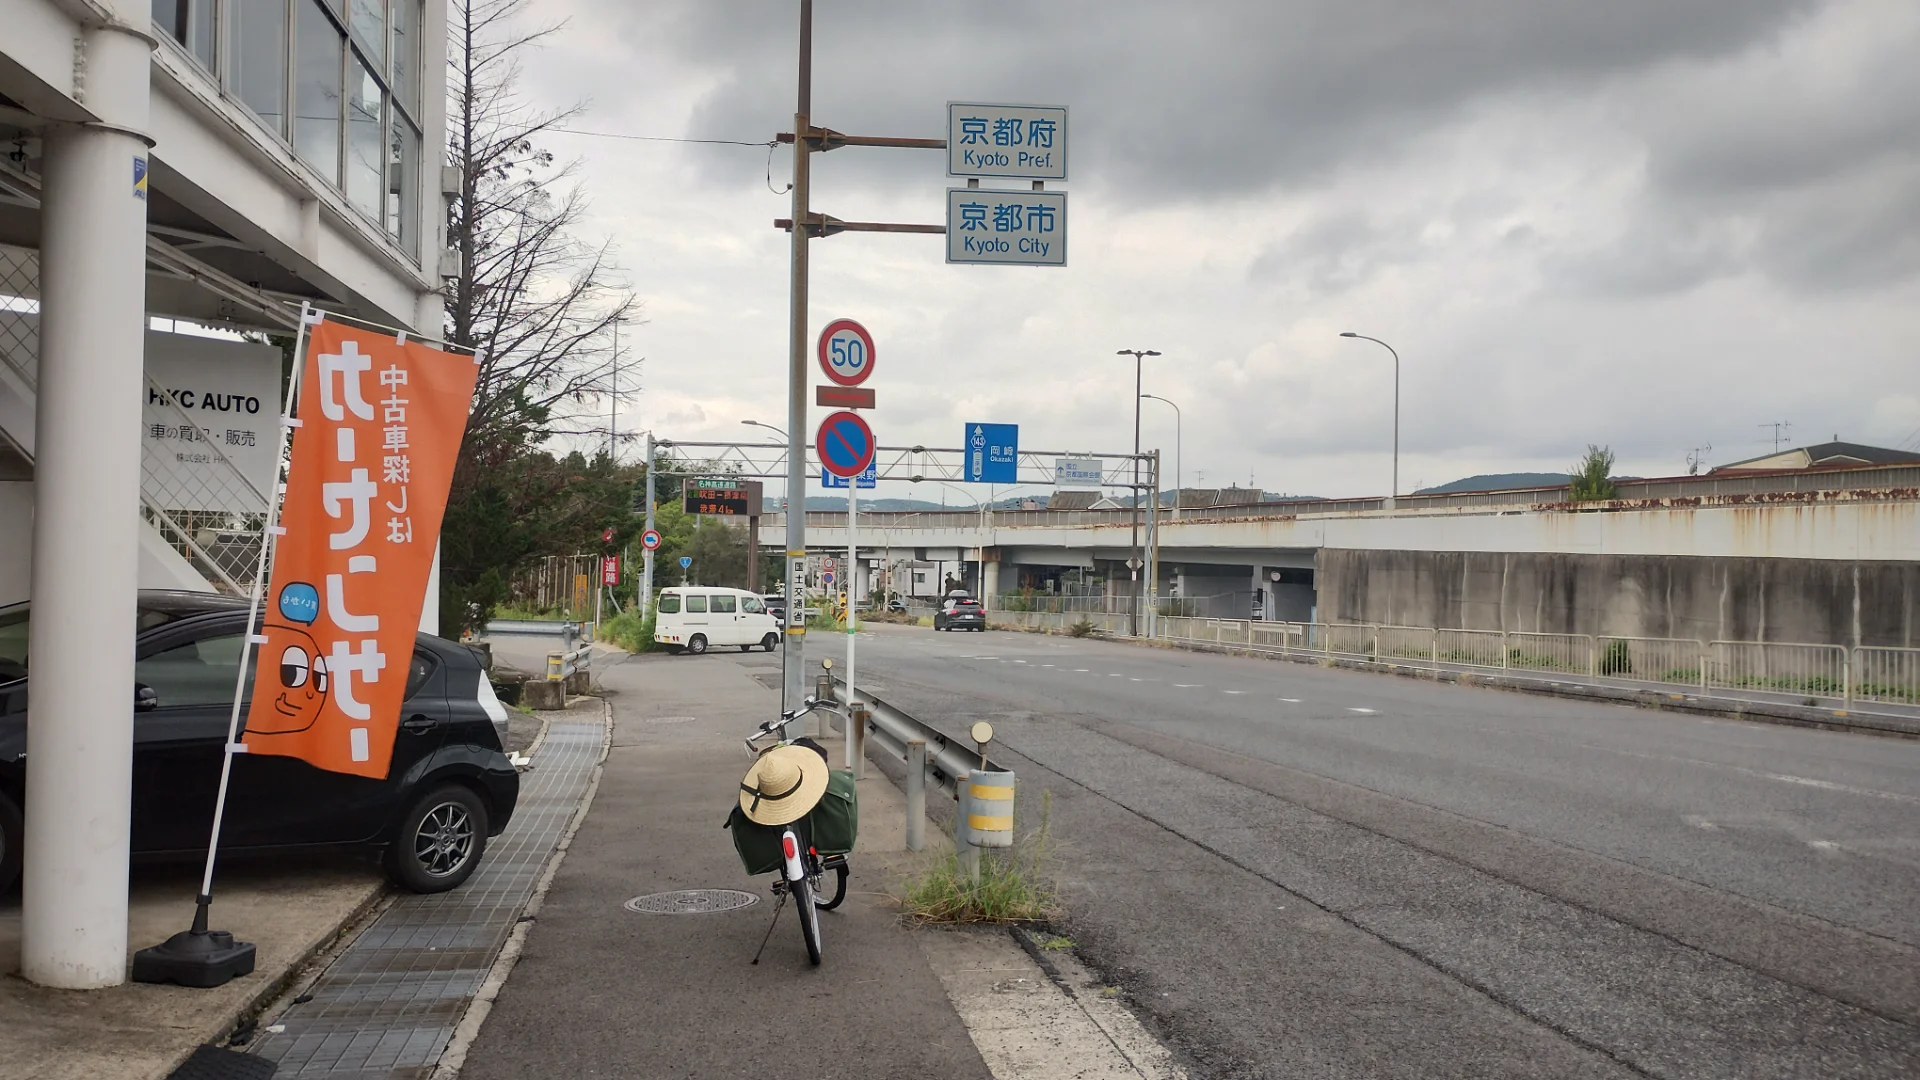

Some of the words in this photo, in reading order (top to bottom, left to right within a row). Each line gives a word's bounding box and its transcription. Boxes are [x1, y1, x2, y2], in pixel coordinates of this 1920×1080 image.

[959, 116, 1057, 148] 京都府
[964, 149, 1009, 168] Kyoto
[1018, 151, 1053, 168] Pref.
[959, 202, 1056, 233] 京都市
[964, 236, 1010, 255] Kyoto
[1018, 237, 1050, 257] City
[832, 338, 863, 368] 50
[201, 392, 260, 414] AUTO
[973, 437, 984, 446] 143
[990, 445, 1014, 456] 岡崎
[793, 562, 804, 621] 国土交通省
